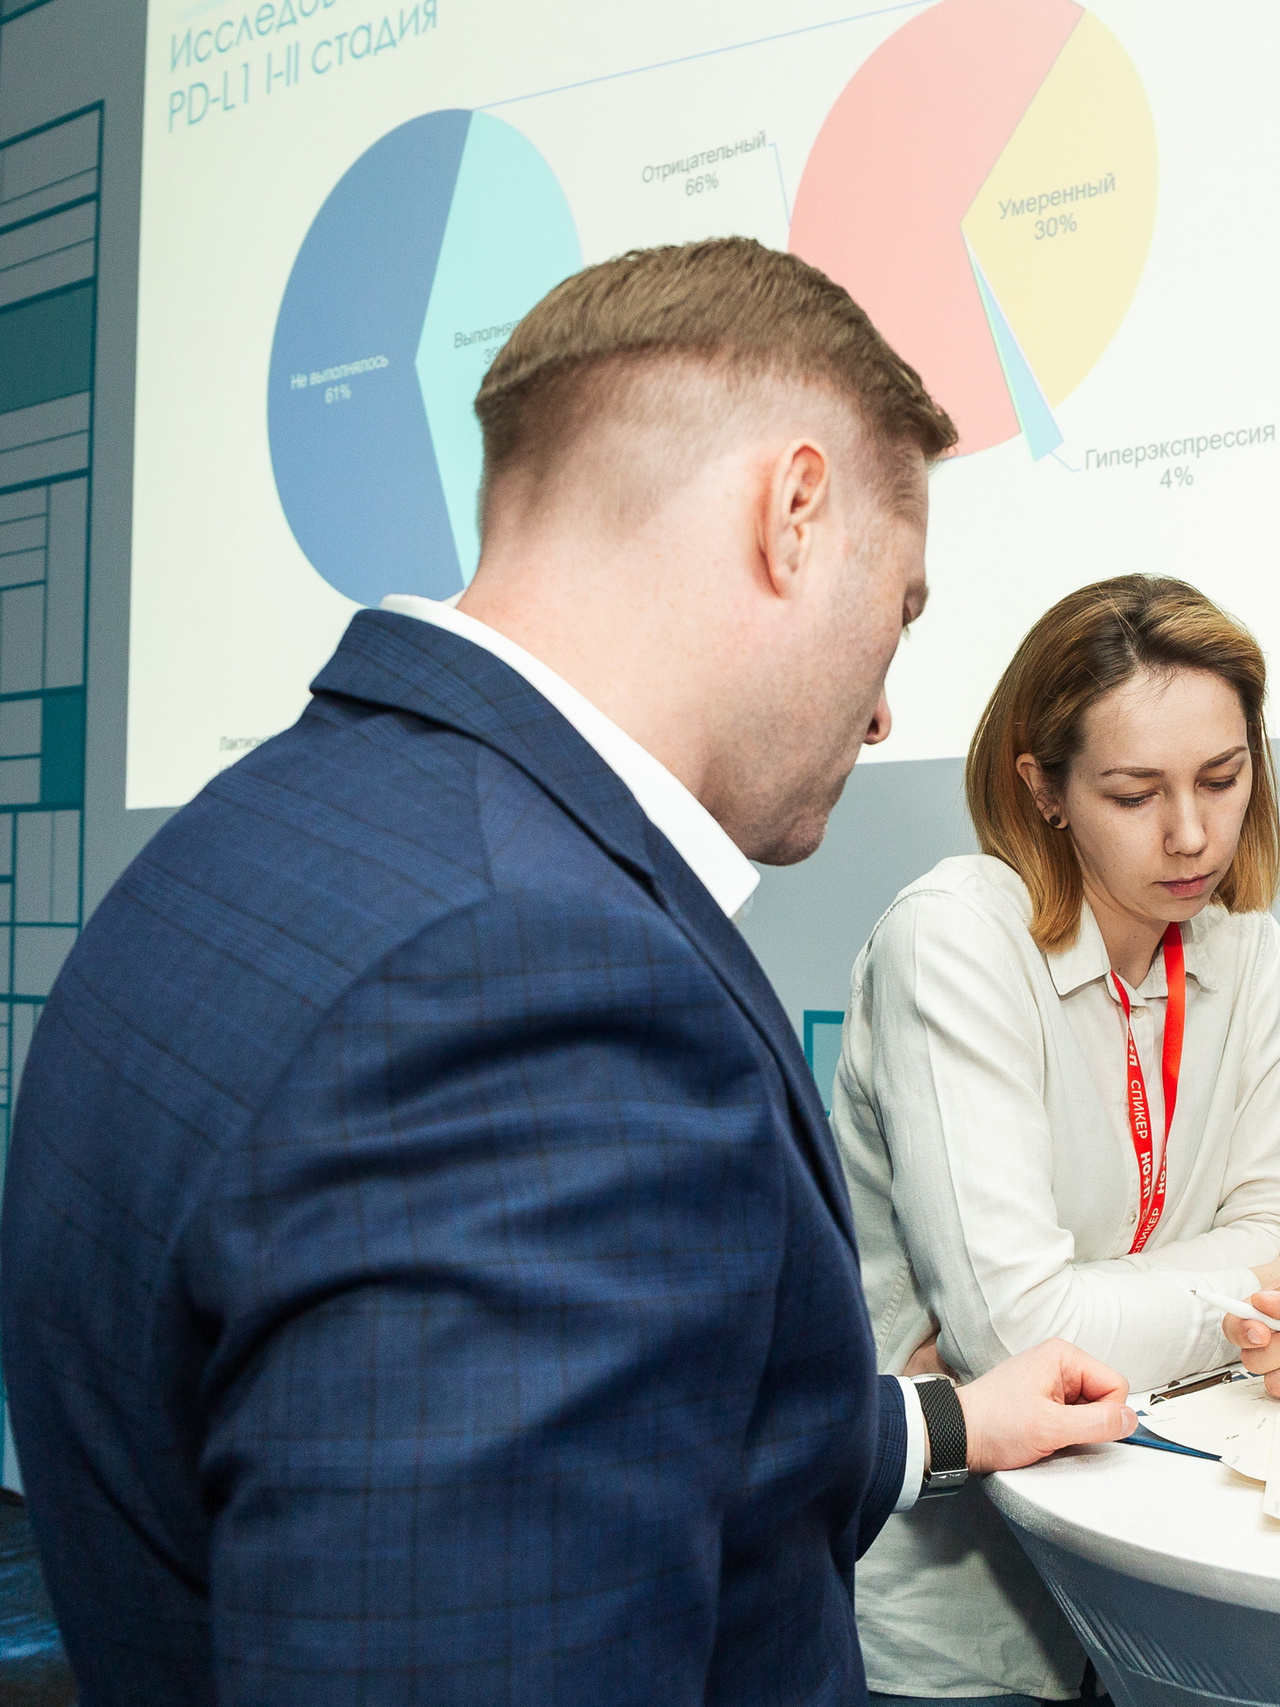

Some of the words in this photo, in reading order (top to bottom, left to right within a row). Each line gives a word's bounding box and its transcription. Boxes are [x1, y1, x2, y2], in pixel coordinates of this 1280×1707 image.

[171, 0, 336, 73] Исследо
[168, 61, 250, 134] PD-L1
[310, 0, 438, 75] стадия
[641, 130, 767, 183] Отрицательный
[685, 172, 719, 197] 66%
[998, 172, 1116, 220] Умеренный
[1034, 212, 1078, 240] 30%
[291, 373, 308, 390] Не
[310, 355, 390, 386] выполнялось
[325, 384, 352, 404] 61%
[1085, 424, 1276, 470] Гиперэкспрессия
[1160, 465, 1195, 488] 4%
[1131, 1080, 1149, 1139] СПИКЕР
